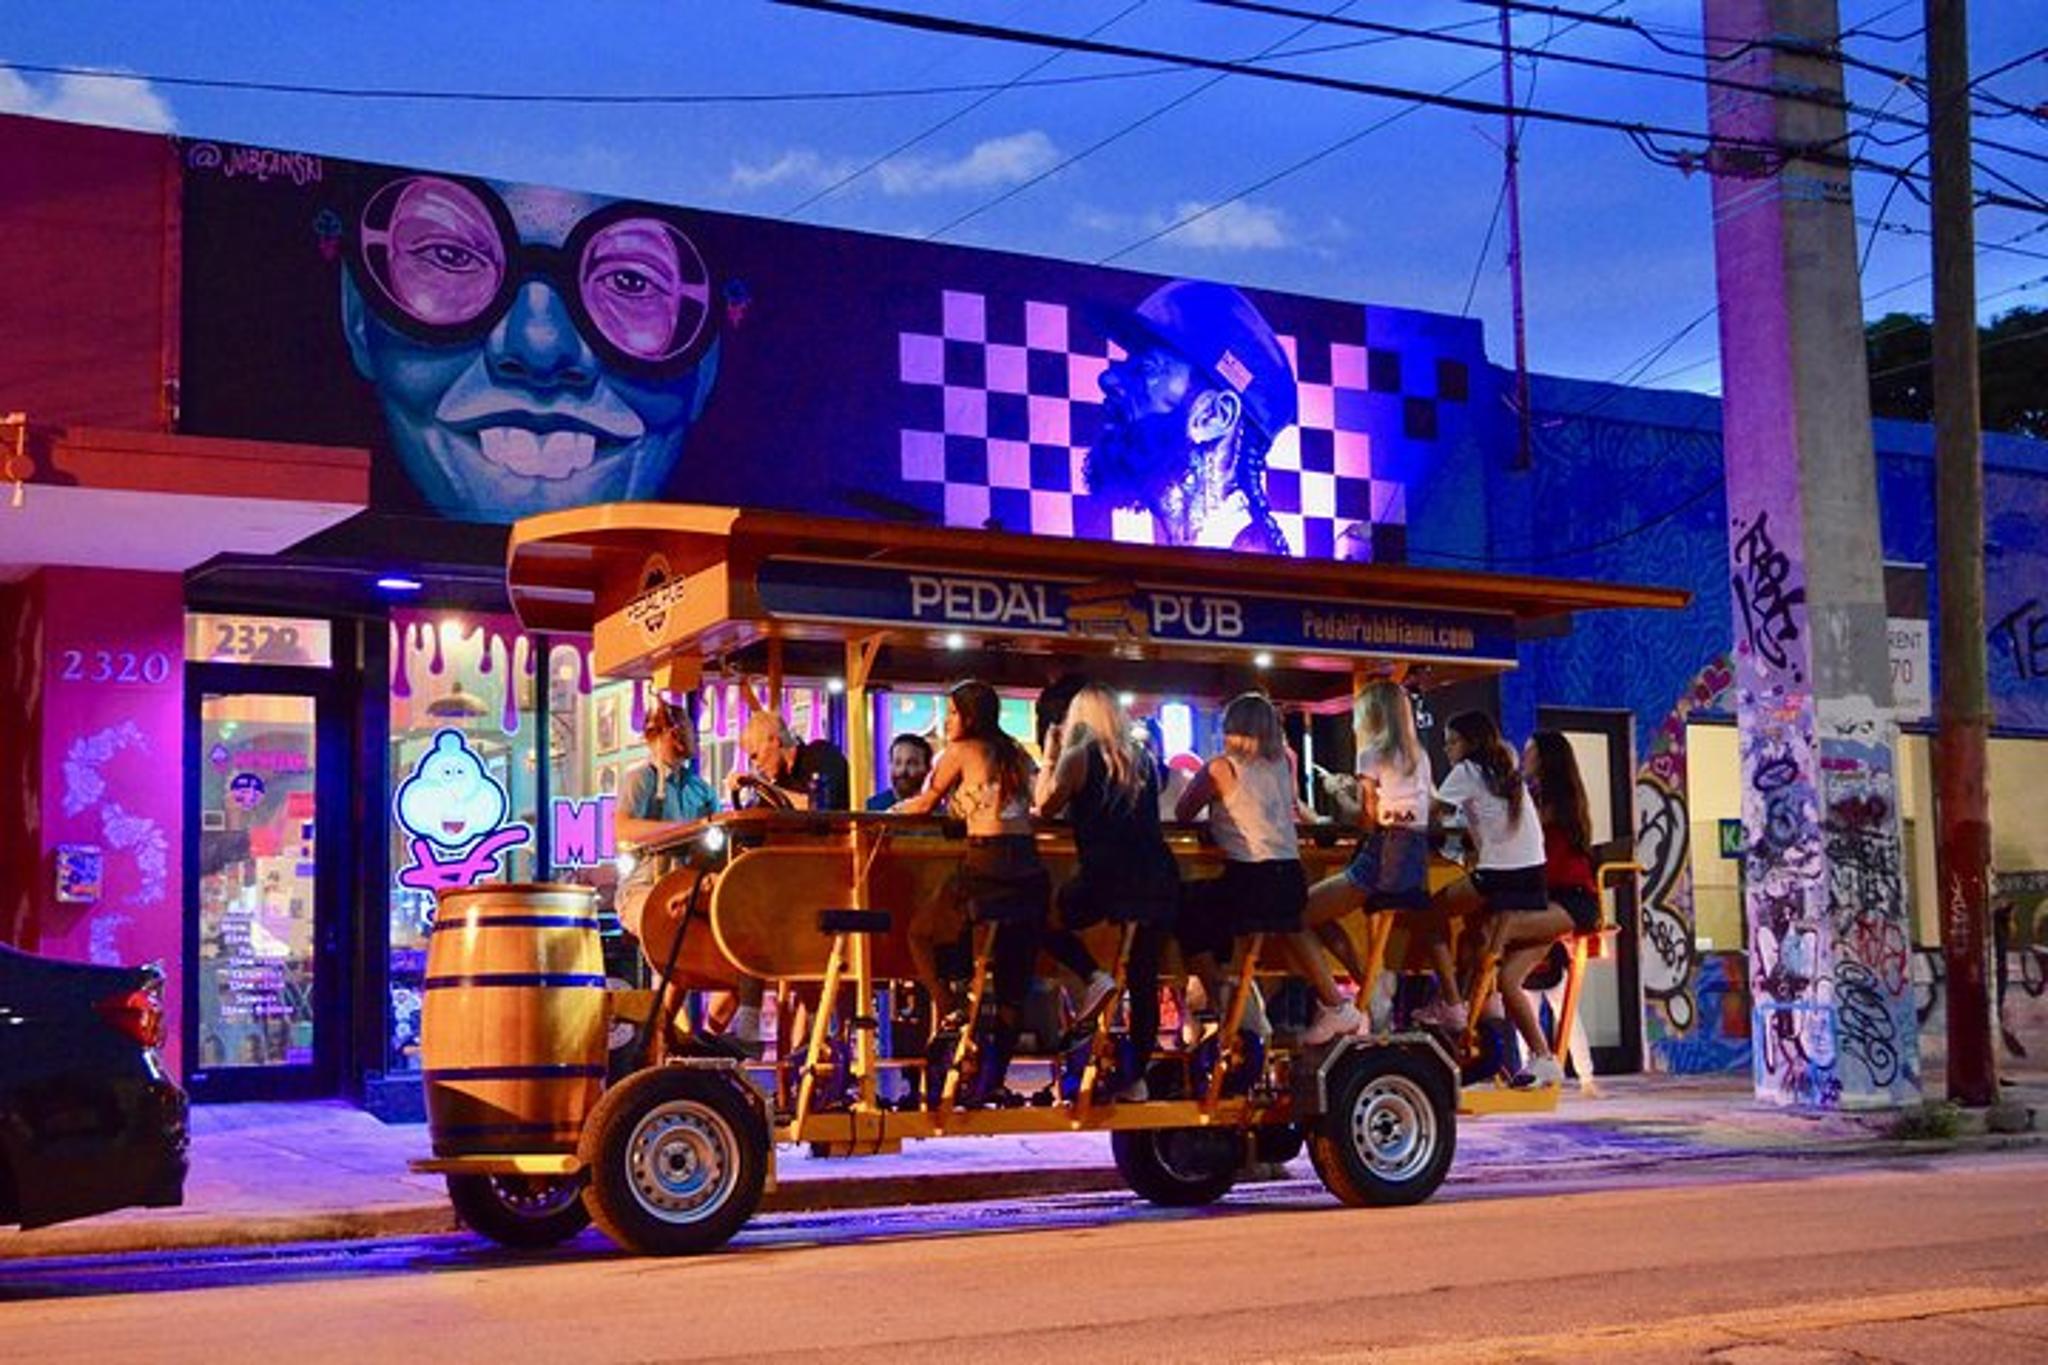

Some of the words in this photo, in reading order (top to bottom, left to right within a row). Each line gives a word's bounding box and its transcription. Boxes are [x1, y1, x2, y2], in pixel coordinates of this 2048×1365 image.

[909, 576, 1064, 627] PEDAL
[1149, 593, 1245, 638] PUB
[1302, 608, 1476, 650] PedalPubMiami.com
[62, 649, 170, 684] 2320
